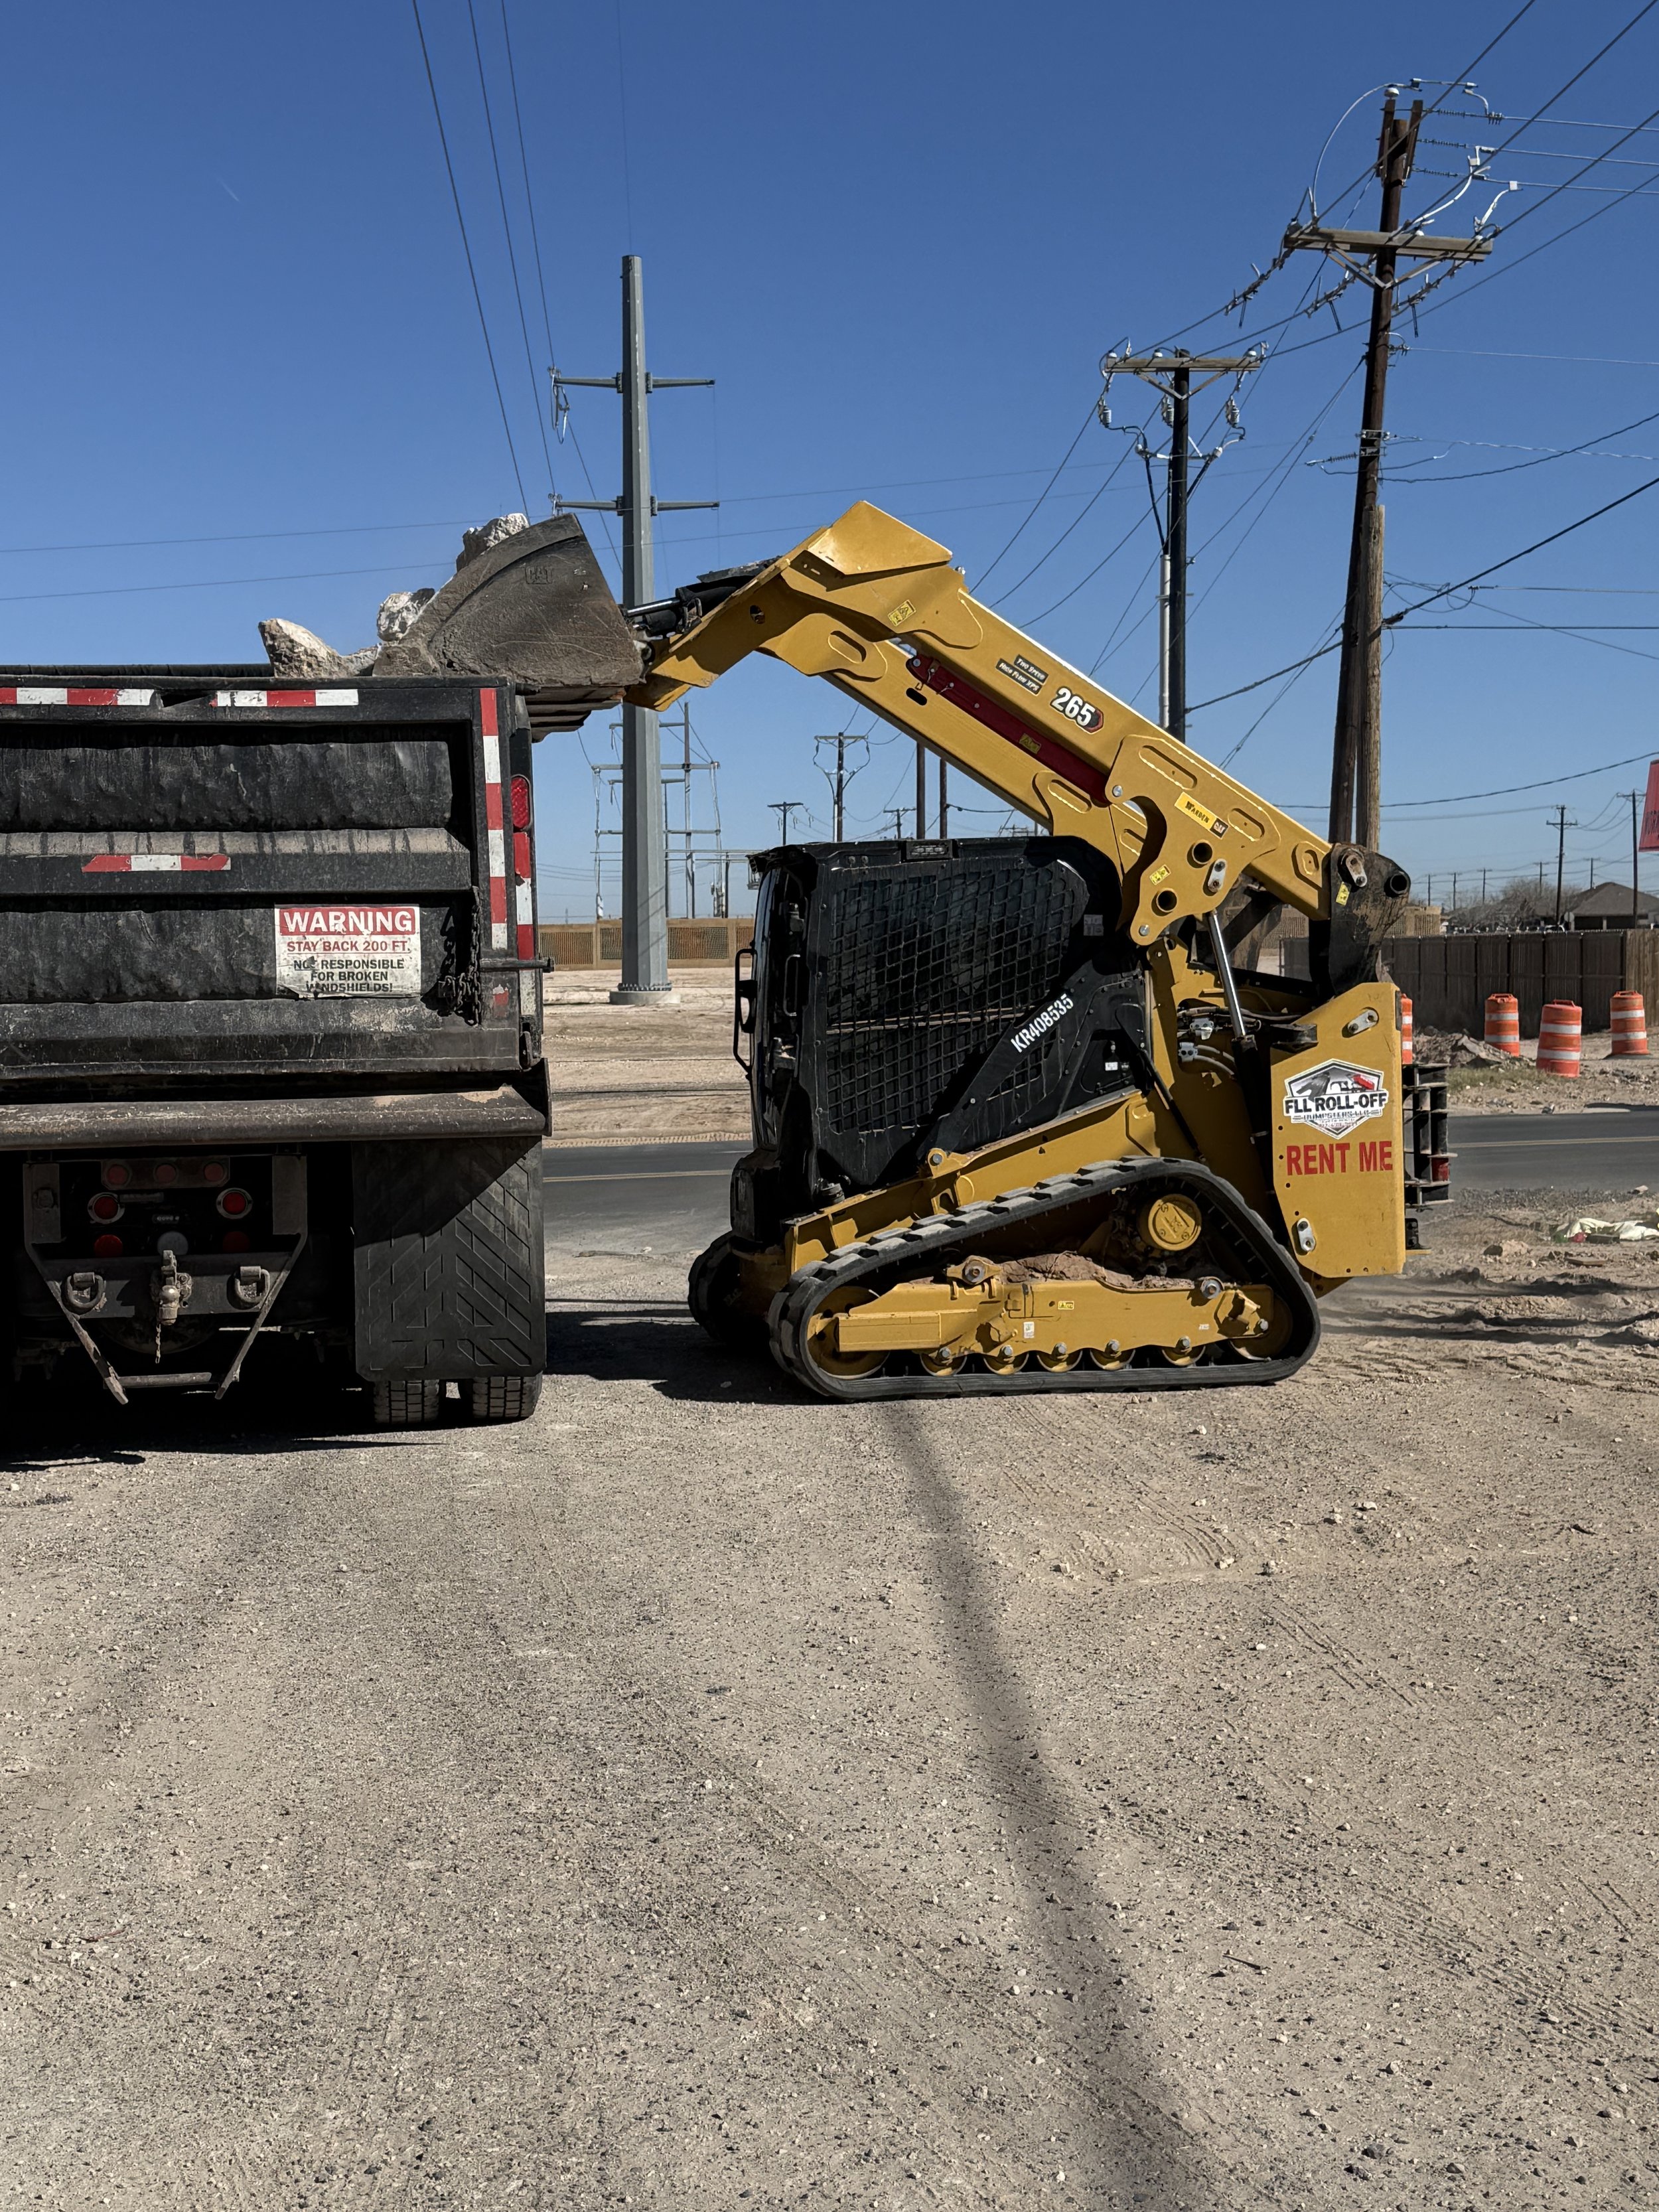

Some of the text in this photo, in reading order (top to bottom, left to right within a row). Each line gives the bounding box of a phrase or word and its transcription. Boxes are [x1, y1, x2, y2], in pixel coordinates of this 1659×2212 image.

[1051, 687, 1096, 726] 265
[283, 911, 413, 932] WARNING
[287, 940, 319, 952] STAY
[323, 940, 359, 952] BACK
[363, 940, 388, 951] 200
[294, 959, 404, 970] NO RESPONSIBLE
[306, 982, 393, 992] WNDSHIELDS!
[311, 972, 388, 982] FOR BROKEN
[1011, 994, 1074, 1053] KR408535
[1285, 1093, 1387, 1114] FLL ROLL-OFF
[1286, 1141, 1393, 1175] RENT ME
